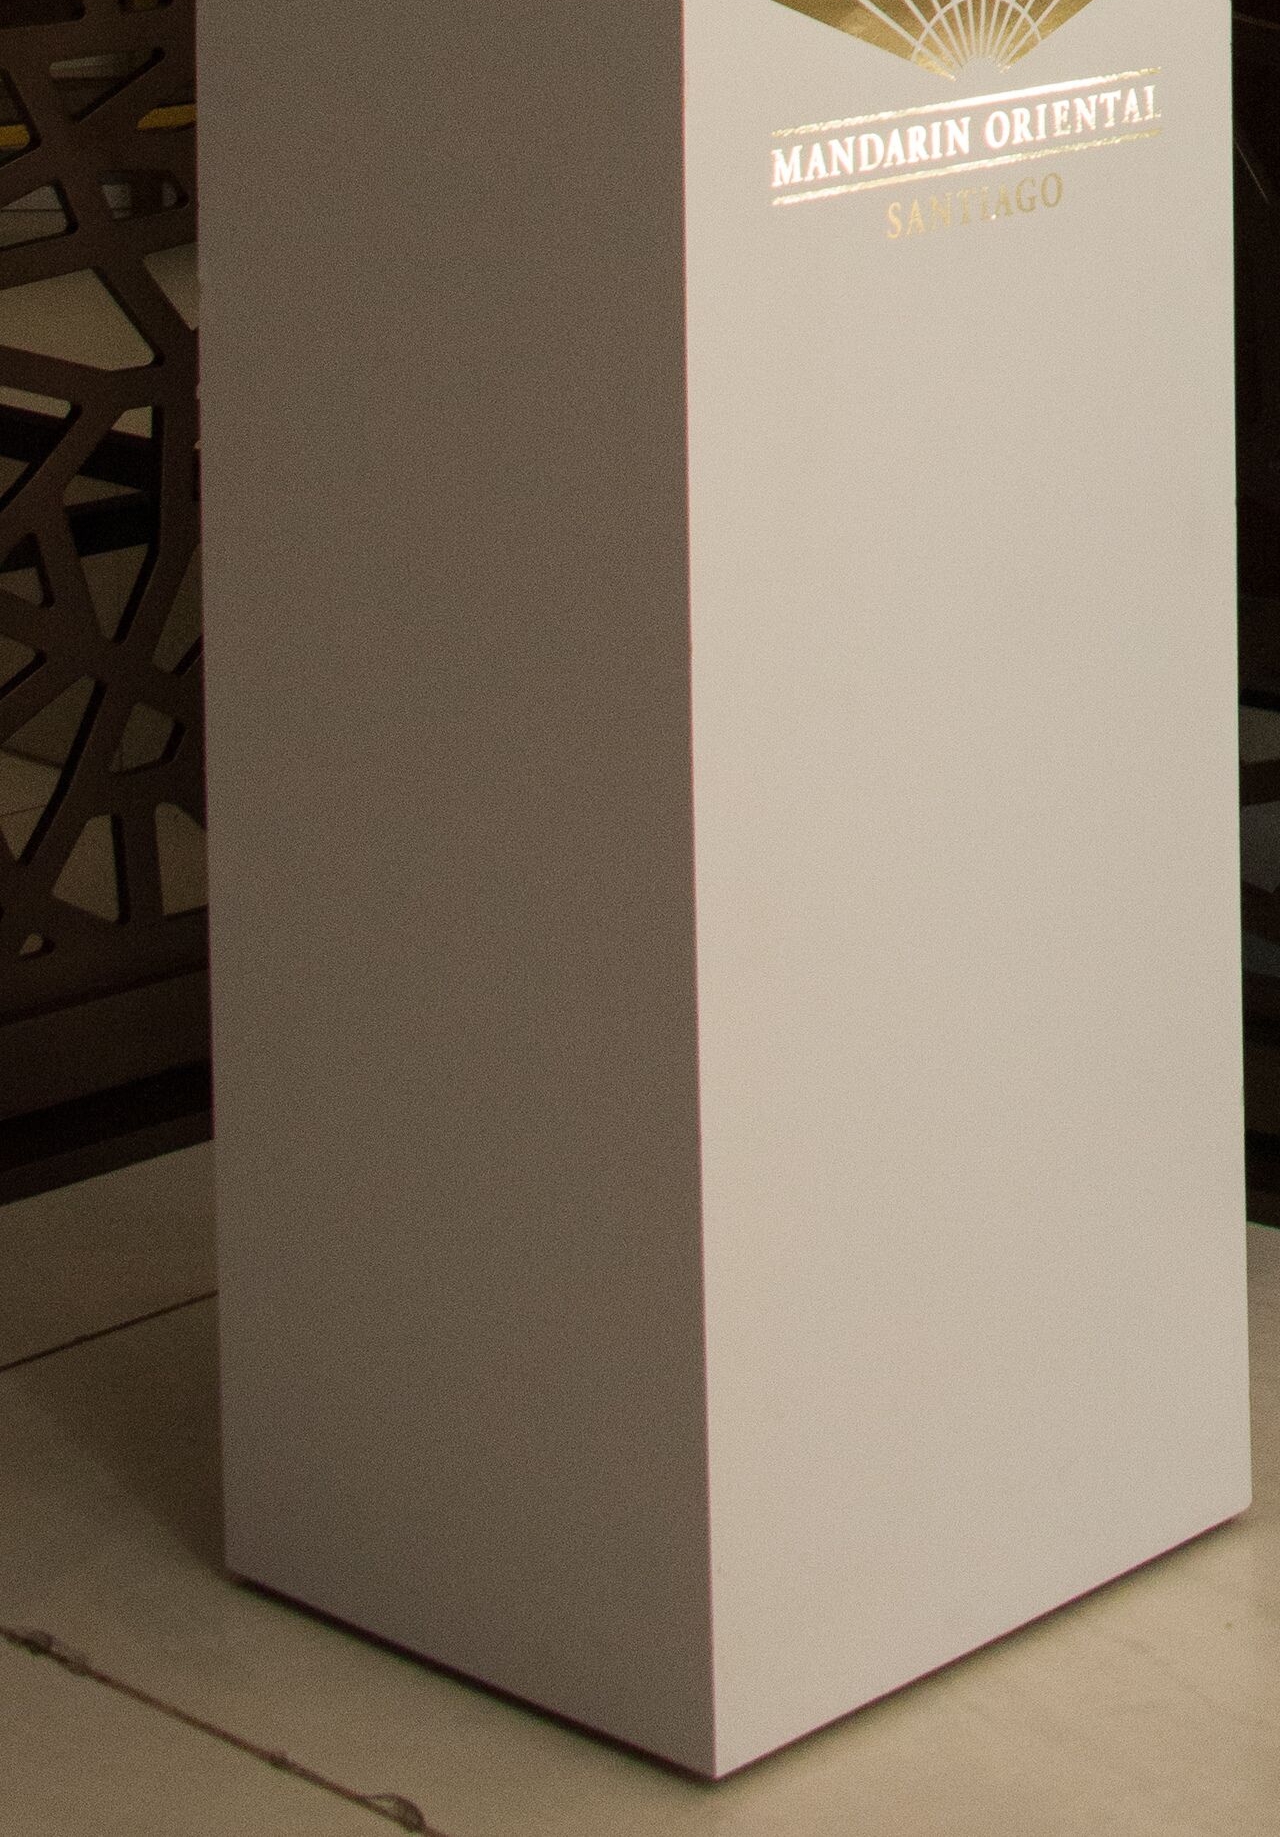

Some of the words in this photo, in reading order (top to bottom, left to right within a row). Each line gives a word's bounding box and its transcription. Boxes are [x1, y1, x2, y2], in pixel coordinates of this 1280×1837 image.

[770, 116, 971, 189] MANDARIN
[984, 84, 1162, 151] ORIENTAL
[886, 172, 1065, 240] SANTIAGO
